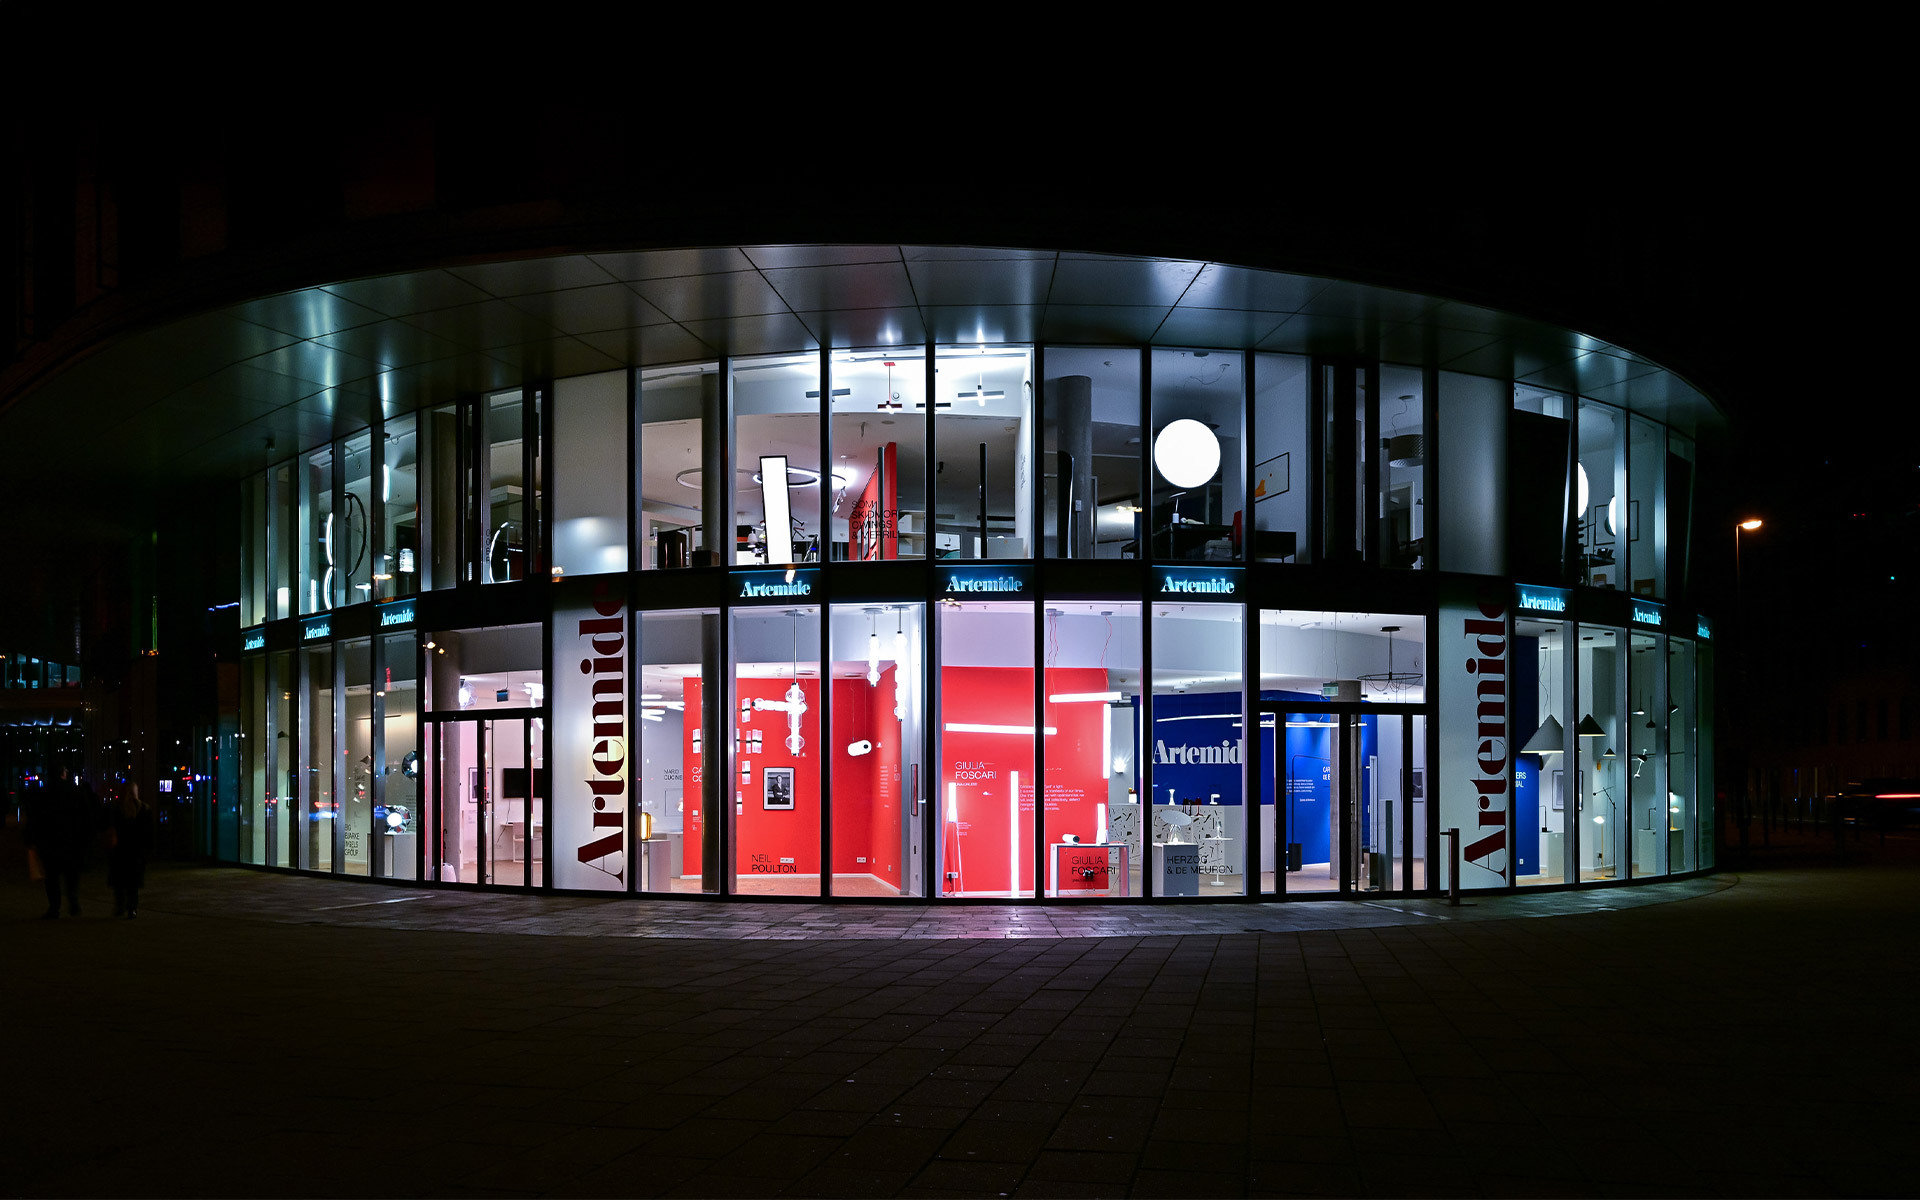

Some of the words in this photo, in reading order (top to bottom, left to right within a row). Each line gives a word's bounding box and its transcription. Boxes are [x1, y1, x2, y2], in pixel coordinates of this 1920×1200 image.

[851, 510, 898, 519] SKIDMOR
[740, 581, 811, 598] Artemide
[945, 576, 1023, 593] Artemide
[1160, 576, 1235, 594] Artemide
[1518, 593, 1566, 612] Artemide
[381, 609, 414, 627] Artemide
[304, 624, 330, 640] Artemide
[1152, 739, 1243, 764] Artemid
[955, 761, 986, 770] GIULIA
[955, 771, 997, 780] FOSCARI
[751, 854, 772, 863] NEIL
[1071, 855, 1104, 865] GIULIA
[1166, 855, 1208, 865] HERZOG
[751, 864, 797, 873] POULTON
[1166, 865, 1173, 875] &
[1175, 866, 1188, 875] DE
[1190, 865, 1233, 875] MEURON
